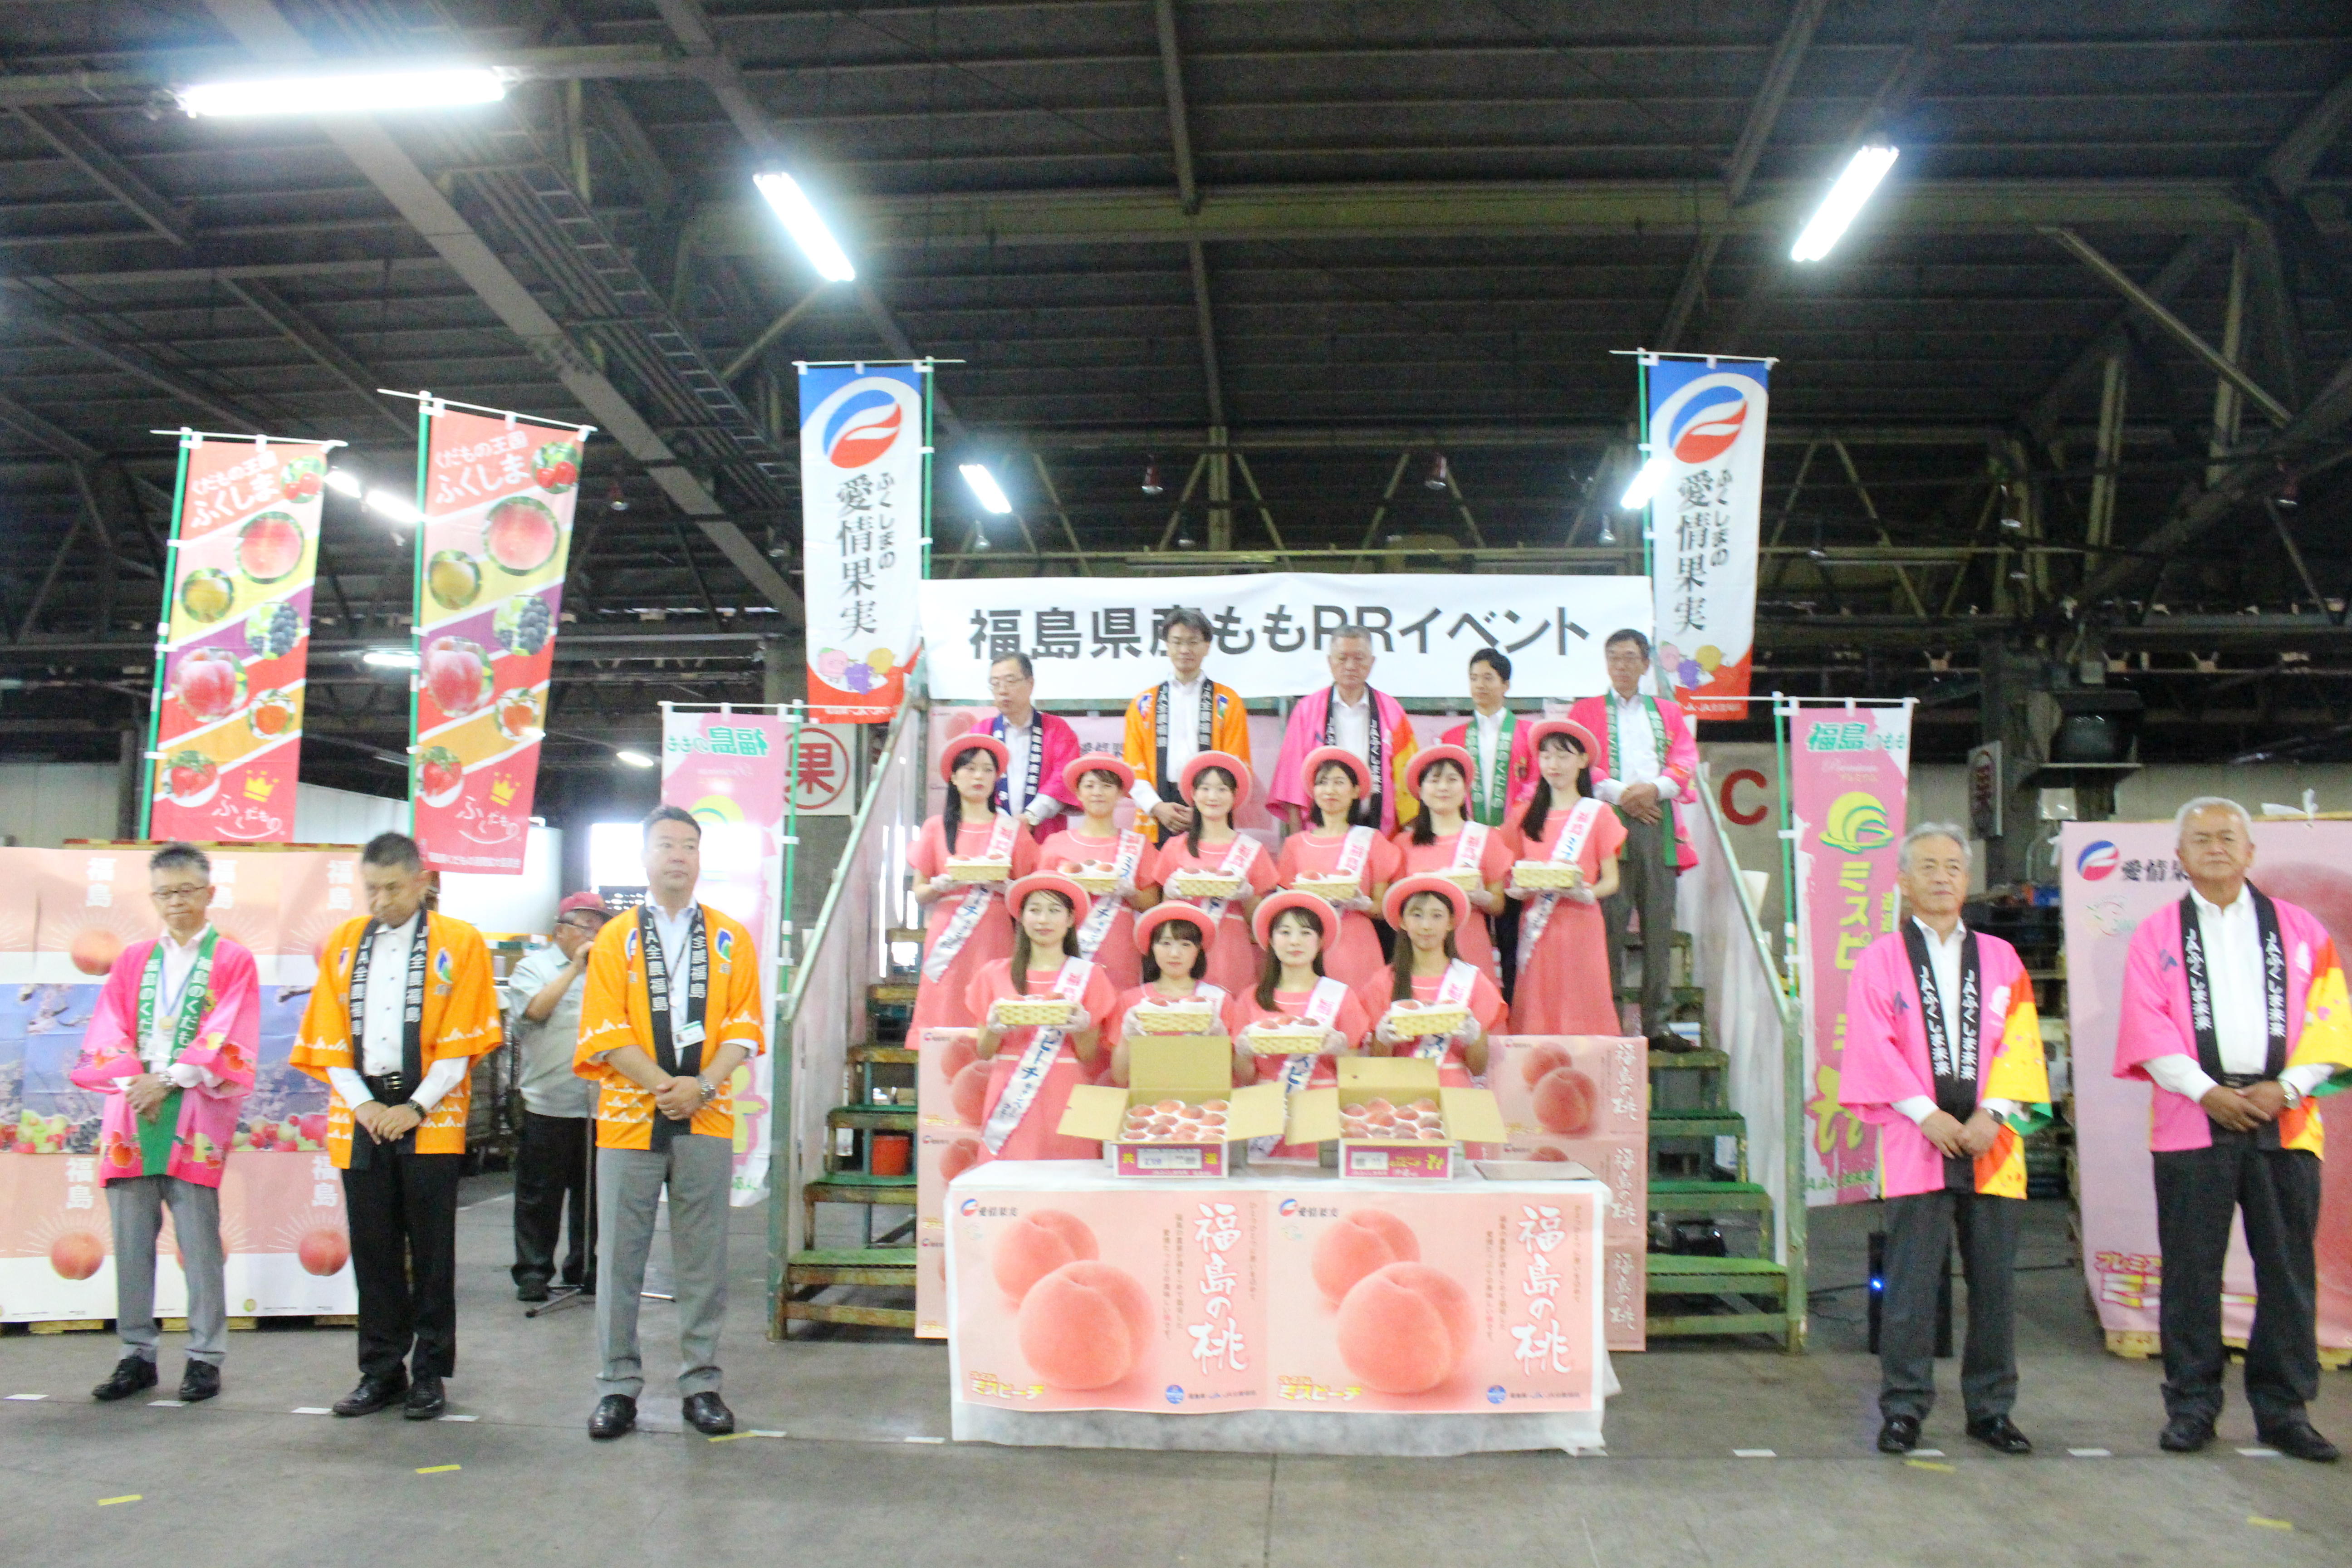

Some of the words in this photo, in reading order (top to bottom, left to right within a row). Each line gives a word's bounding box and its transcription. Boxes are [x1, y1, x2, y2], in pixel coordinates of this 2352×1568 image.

[435, 431, 529, 468] くだもの王国
[191, 473, 279, 528] ふくしま
[436, 454, 530, 504] ふくしま
[876, 472, 896, 571] ふくしまの
[837, 473, 877, 641] 愛情果実
[1674, 469, 1713, 632] 愛情果実
[785, 742, 835, 794] 果
[1720, 769, 1768, 826] C
[86, 858, 117, 907] 福島
[327, 860, 354, 910] 福島
[644, 918, 670, 1012] JA全農福島
[65, 1157, 95, 1209] 福島
[312, 1156, 338, 1207] 福島
[1187, 1203, 1248, 1374] 福島の桃
[1510, 1205, 1572, 1376] 福島の桃
[971, 1379, 1044, 1400] ミスピーチ
[1278, 1383, 1362, 1401] ミスピーチ
